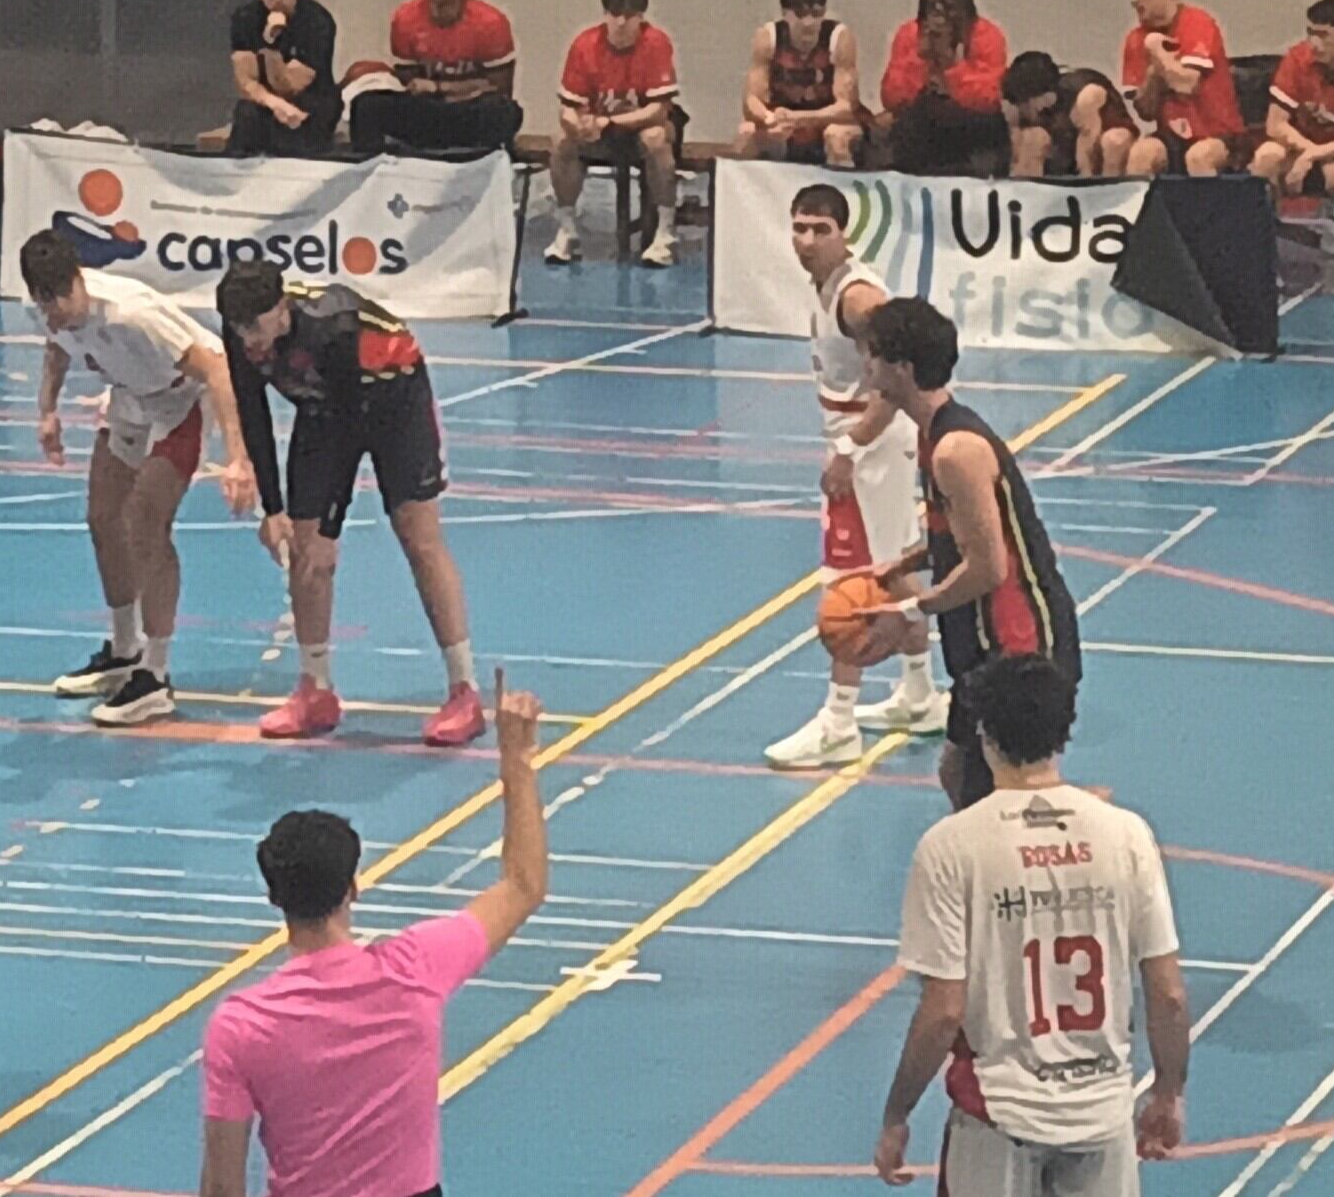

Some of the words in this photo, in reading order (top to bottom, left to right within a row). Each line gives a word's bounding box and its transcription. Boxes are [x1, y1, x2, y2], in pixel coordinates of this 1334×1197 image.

[950, 187, 1129, 264] Vida
[948, 271, 1155, 339] fisio
[1022, 934, 1108, 1039] 13
